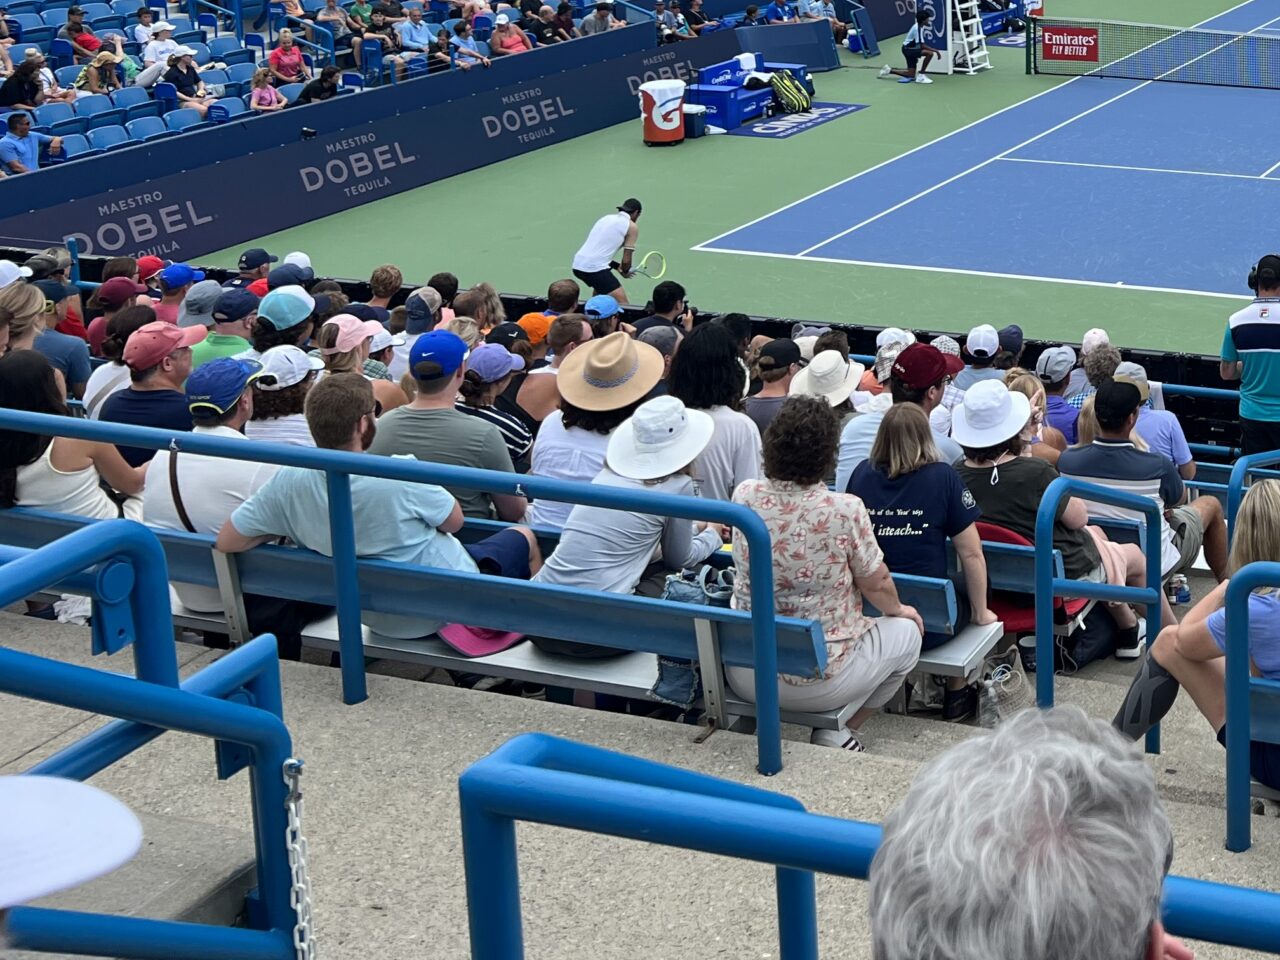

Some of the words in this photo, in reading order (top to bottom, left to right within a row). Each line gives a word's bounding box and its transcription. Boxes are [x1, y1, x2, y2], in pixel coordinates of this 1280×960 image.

[1044, 32, 1095, 46] Emirates
[643, 51, 676, 66] MAESTRO
[1052, 45, 1063, 55] FLY
[1064, 45, 1088, 56] BETTER
[502, 87, 542, 105] MAESTRO
[481, 96, 574, 138] DOBEL
[326, 133, 376, 154] MAESTRO
[517, 126, 556, 144] TEQUILA
[300, 141, 416, 192] DOBEL
[344, 176, 392, 197] TEQUILA
[98, 191, 163, 217] MAESTRO
